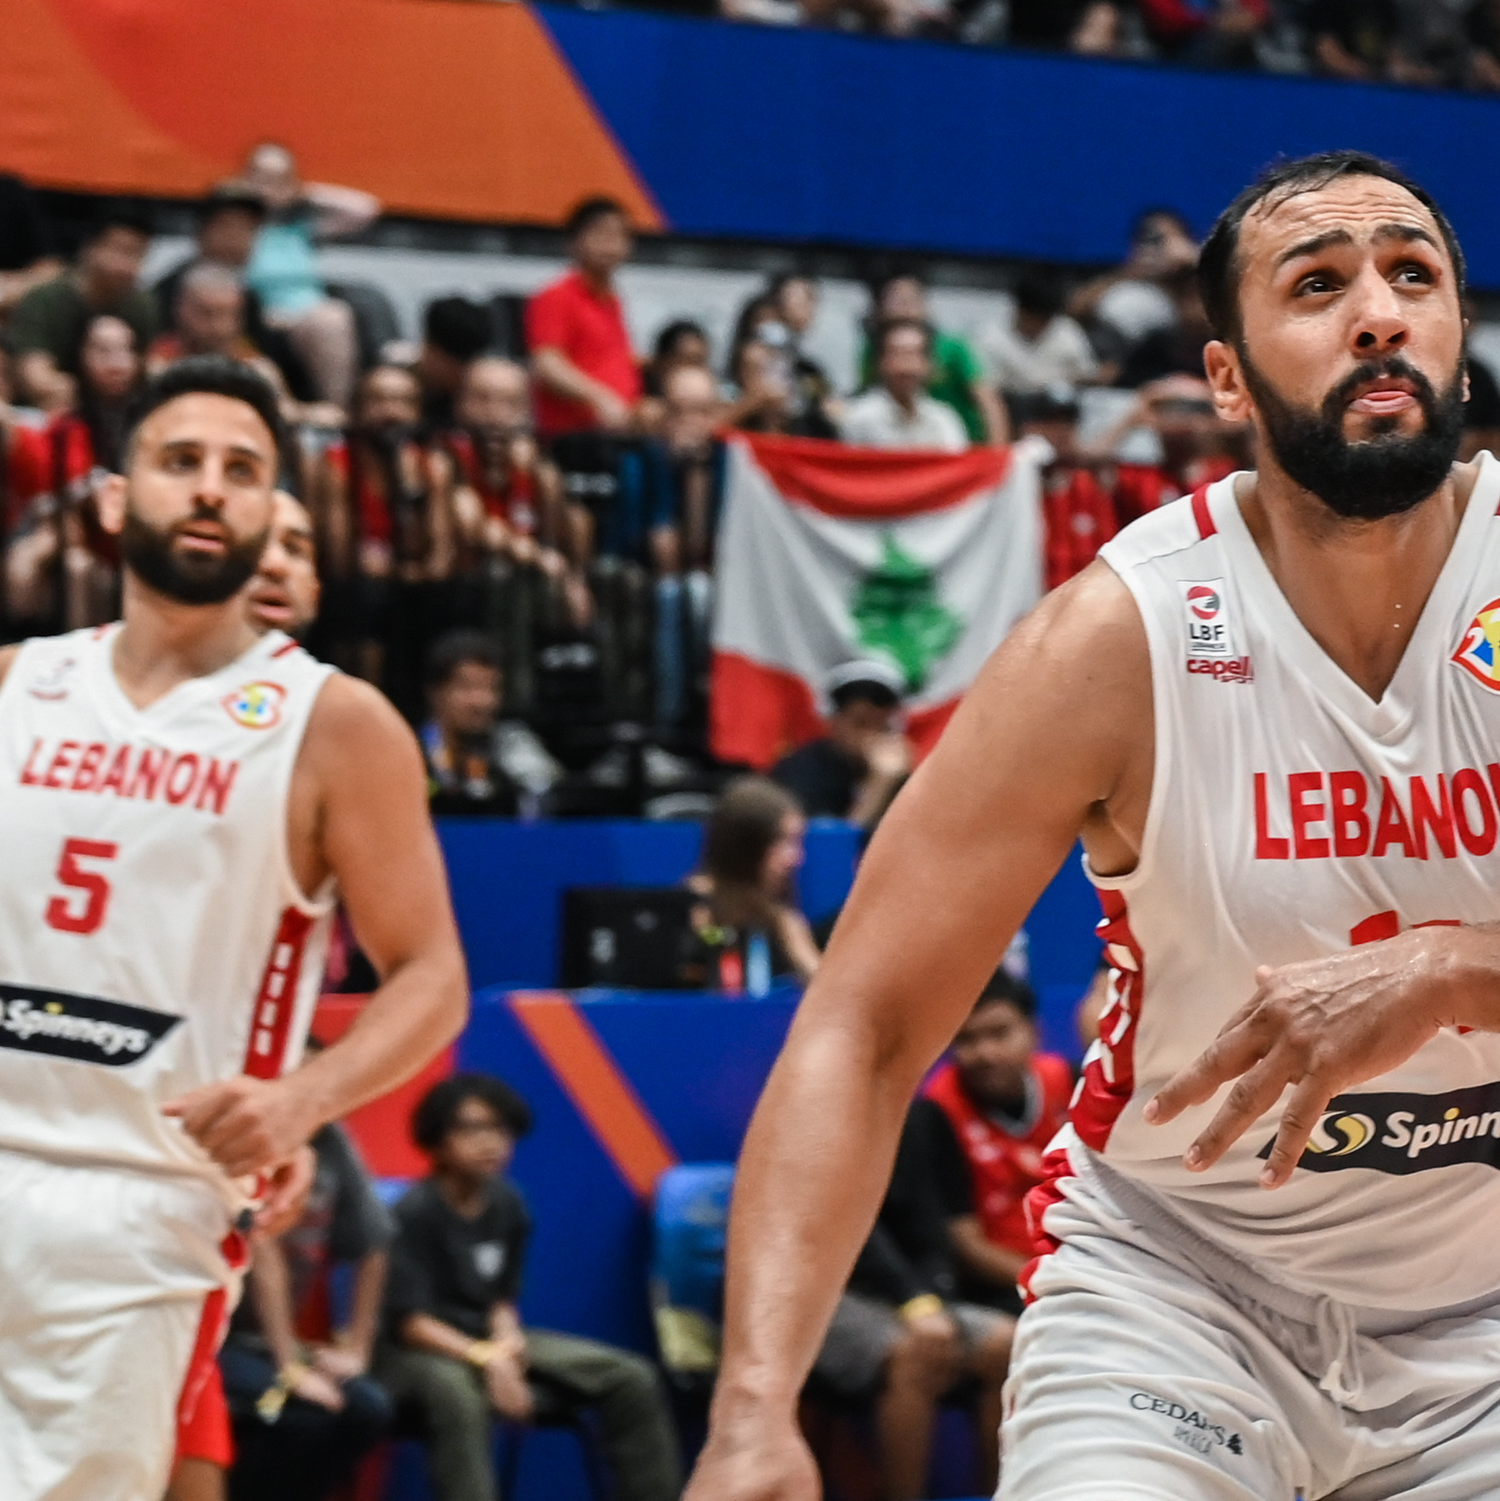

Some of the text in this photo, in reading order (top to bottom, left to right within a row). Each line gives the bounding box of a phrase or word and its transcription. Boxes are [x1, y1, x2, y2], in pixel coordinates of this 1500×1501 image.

[1188, 622, 1225, 641] LBF
[20, 738, 239, 816] LEBANON
[44, 836, 118, 936] 5
